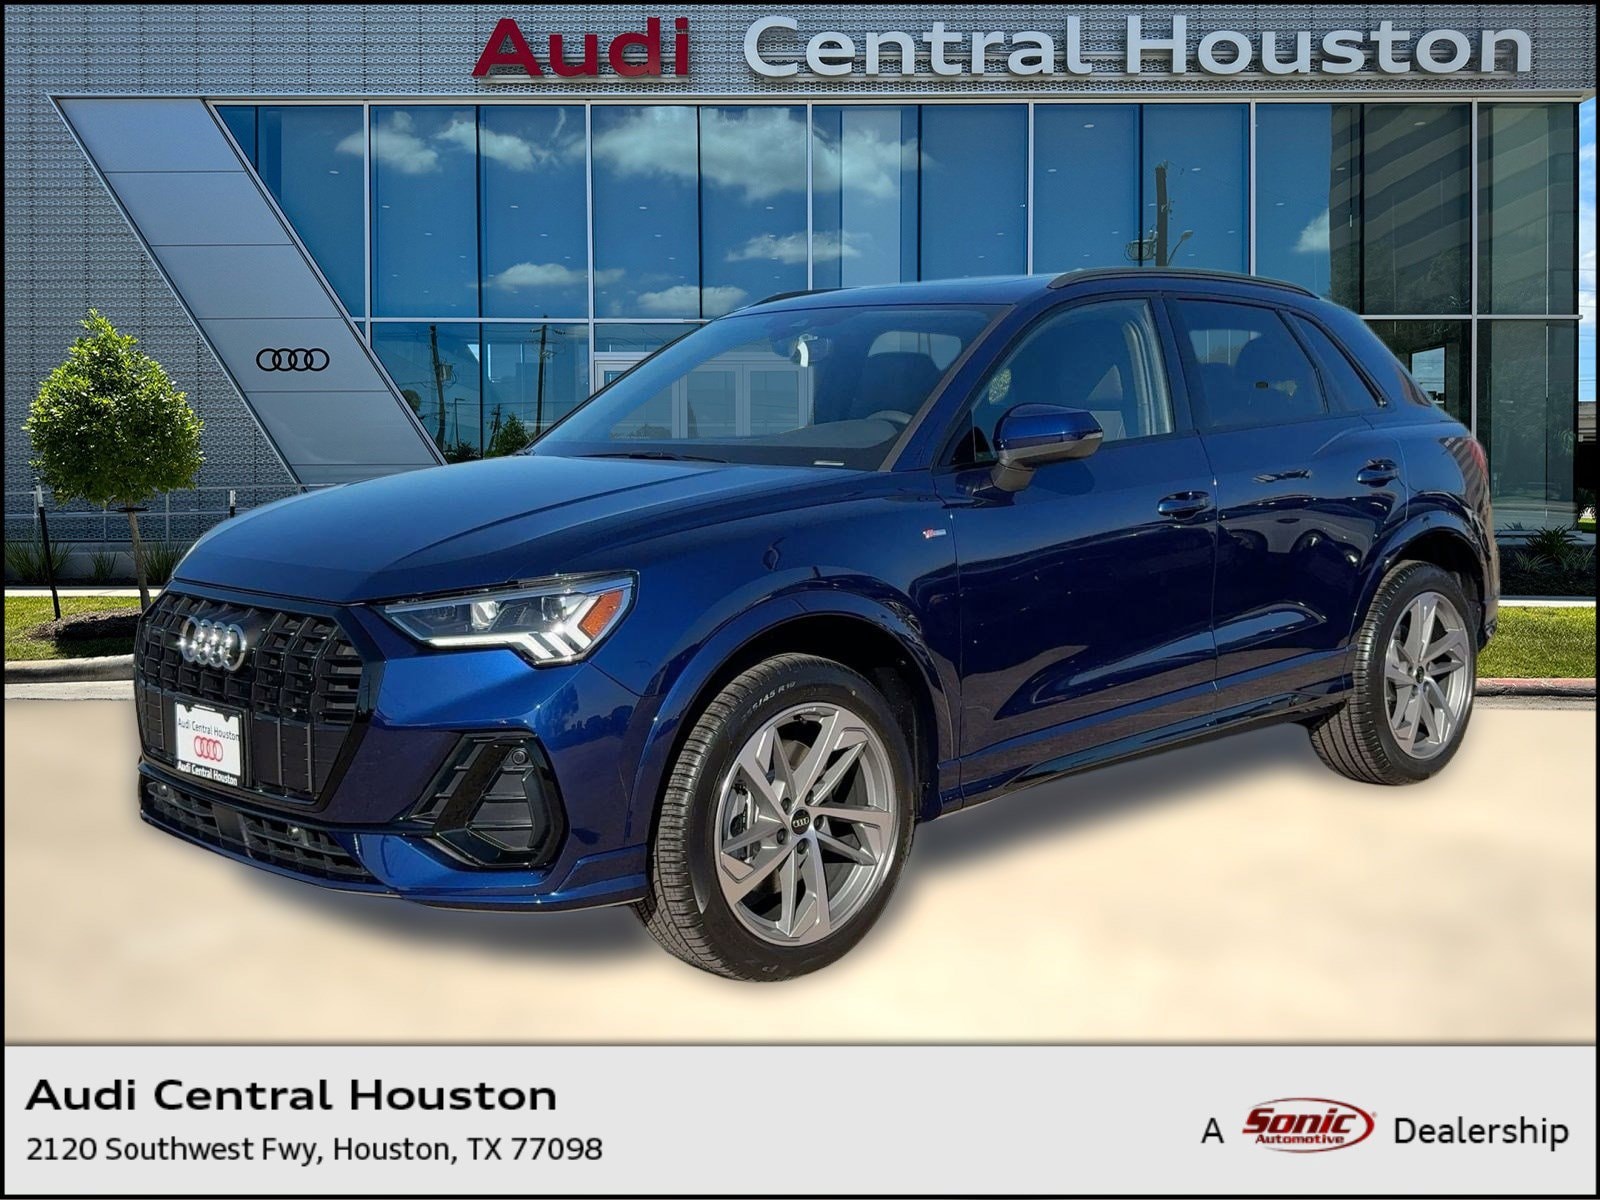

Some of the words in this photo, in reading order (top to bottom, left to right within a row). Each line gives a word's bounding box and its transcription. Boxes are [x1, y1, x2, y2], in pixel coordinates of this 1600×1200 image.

[471, 16, 689, 78] Audi
[743, 15, 1093, 77] Central
[1126, 14, 1533, 76] Houston
[178, 717, 190, 728] Audi
[192, 720, 213, 735] Central
[213, 727, 240, 741] Houston
[178, 761, 191, 773] Audi
[191, 764, 213, 779] Central
[213, 770, 238, 786] Houston
